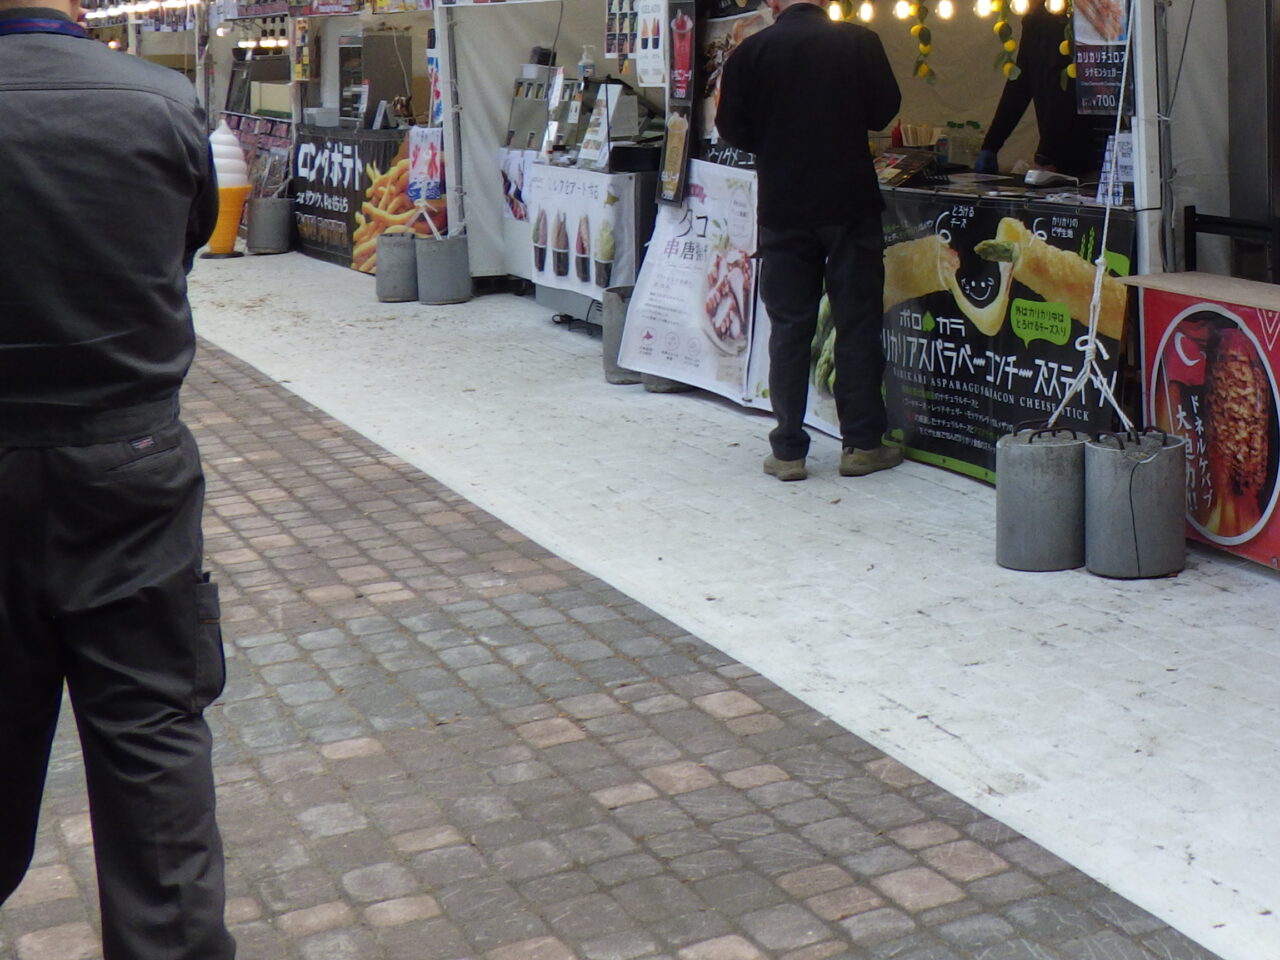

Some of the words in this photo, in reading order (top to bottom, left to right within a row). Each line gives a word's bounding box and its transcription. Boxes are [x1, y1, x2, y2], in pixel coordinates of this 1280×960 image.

[298, 141, 363, 191] ロングポテト
[676, 208, 709, 239] タコ
